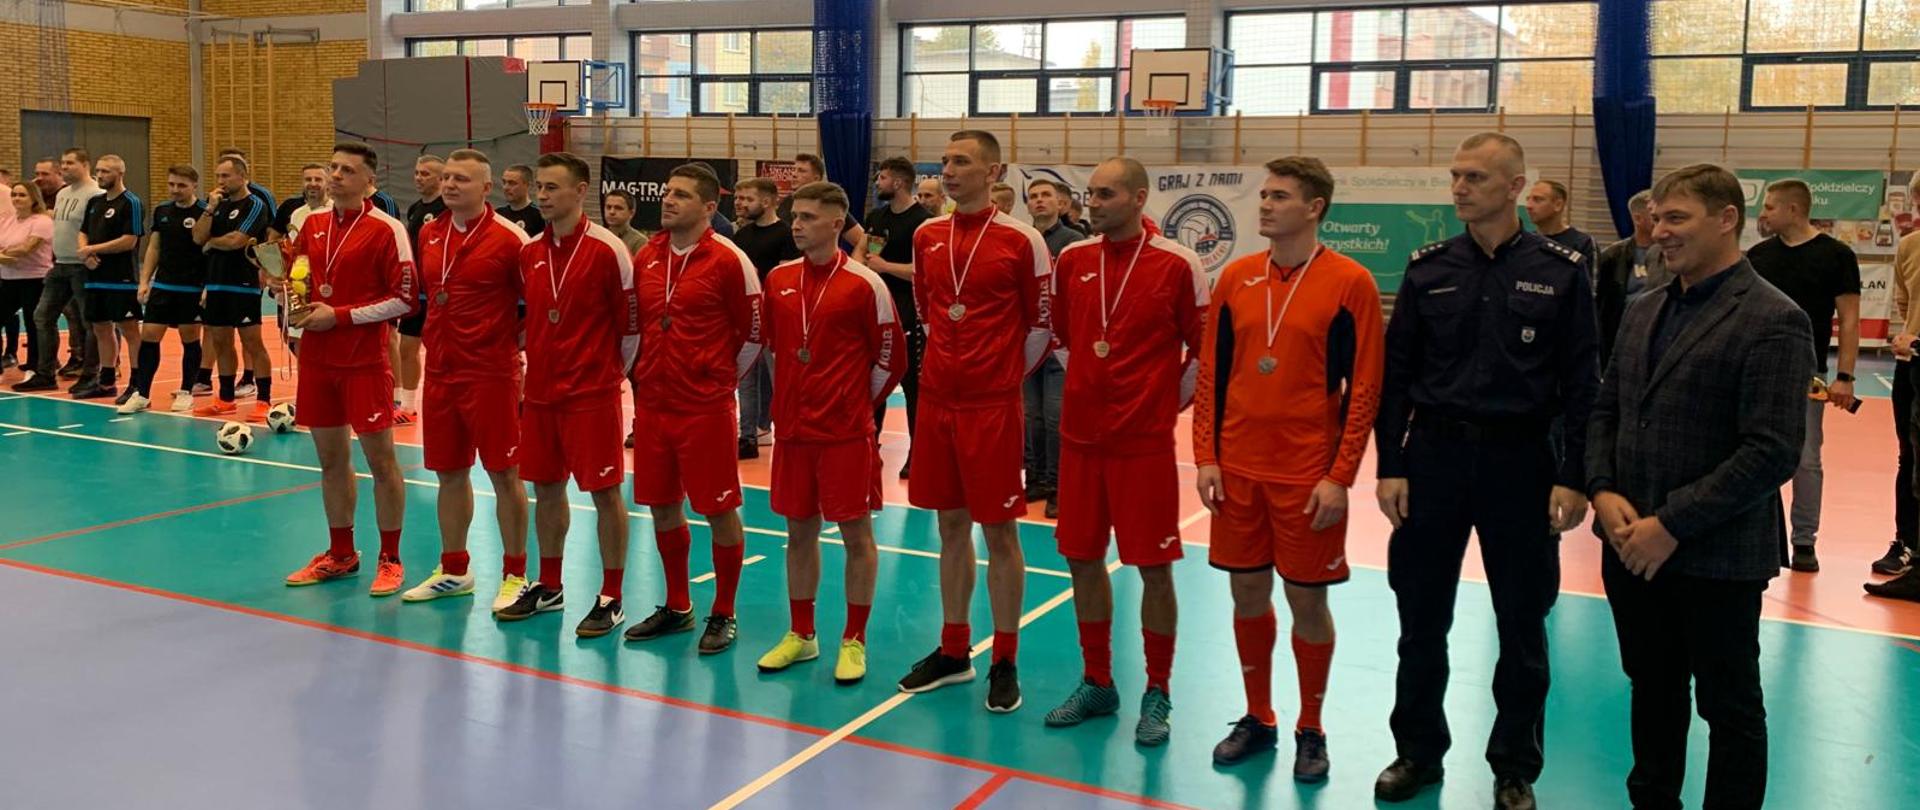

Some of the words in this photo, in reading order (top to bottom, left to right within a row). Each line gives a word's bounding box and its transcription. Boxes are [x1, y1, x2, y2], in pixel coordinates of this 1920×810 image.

[1158, 174, 1191, 191] GRAJ
[1196, 173, 1205, 187] Z
[1808, 180, 1875, 196] półdzielczy
[1321, 220, 1381, 237] Otwarty
[1320, 237, 1390, 251] szystkich!
[1515, 280, 1555, 296] POLICJA
